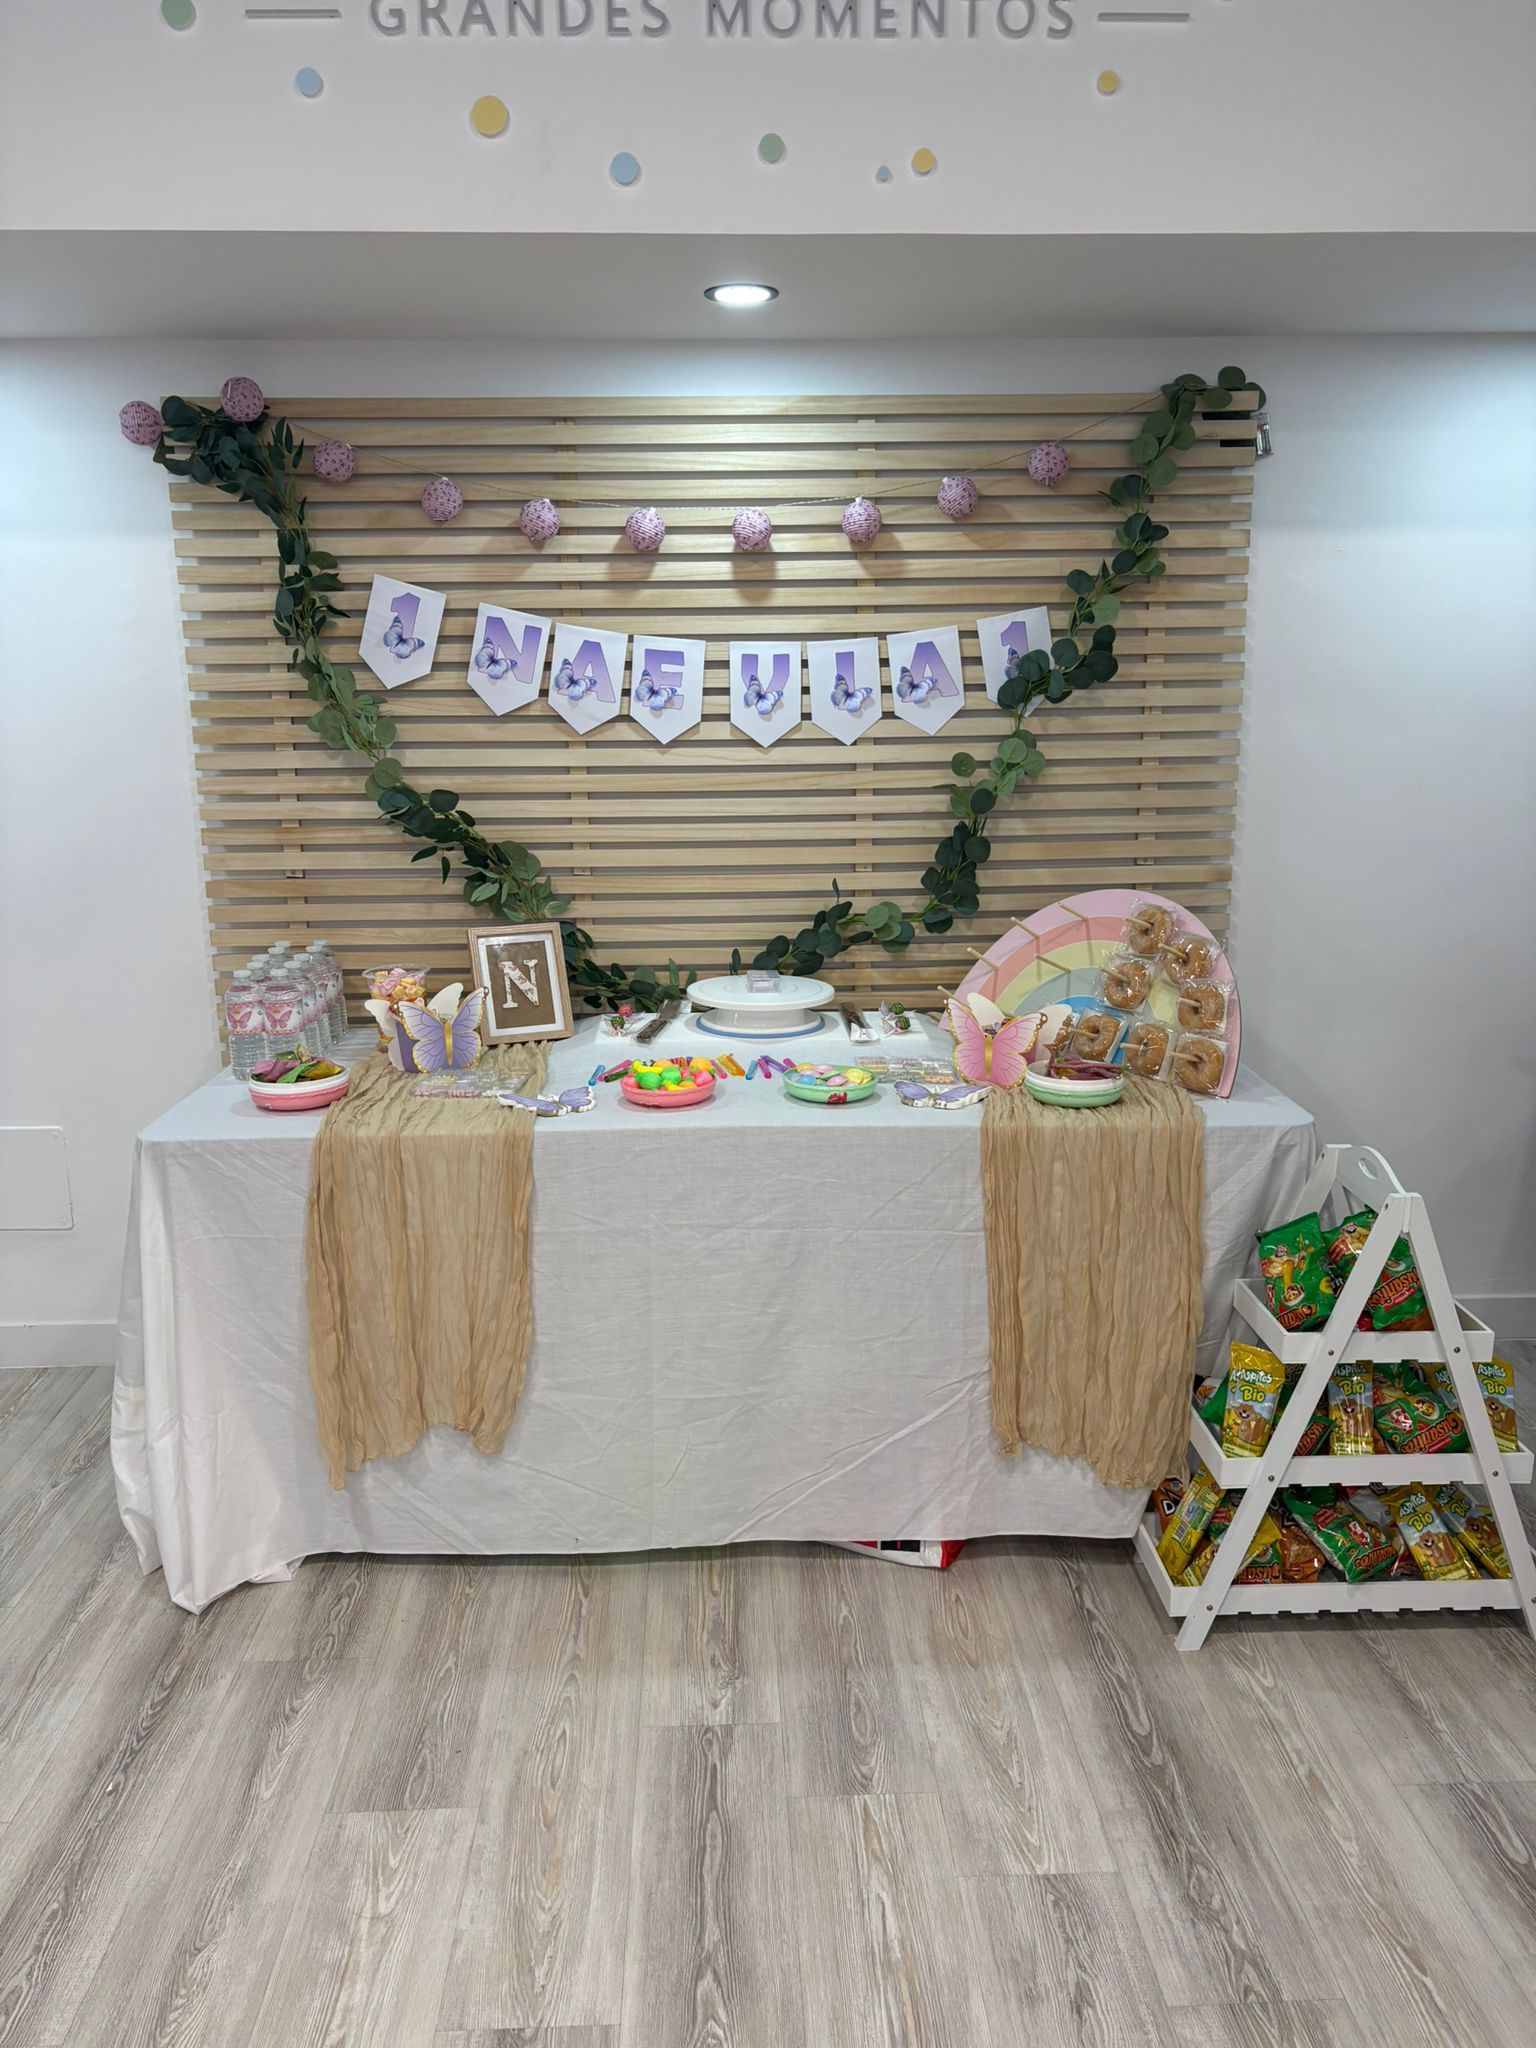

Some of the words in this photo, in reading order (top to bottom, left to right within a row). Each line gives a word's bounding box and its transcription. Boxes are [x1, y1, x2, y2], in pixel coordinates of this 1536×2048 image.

[370, 0, 670, 37] GRANDES
[706, 0, 1074, 39] MOMENTOS
[499, 959, 540, 1009] N
[1240, 1385, 1265, 1402] Bio
[1339, 1380, 1365, 1396] Bio
[1482, 1379, 1506, 1395] Bio
[1408, 1512, 1434, 1532] Bio
